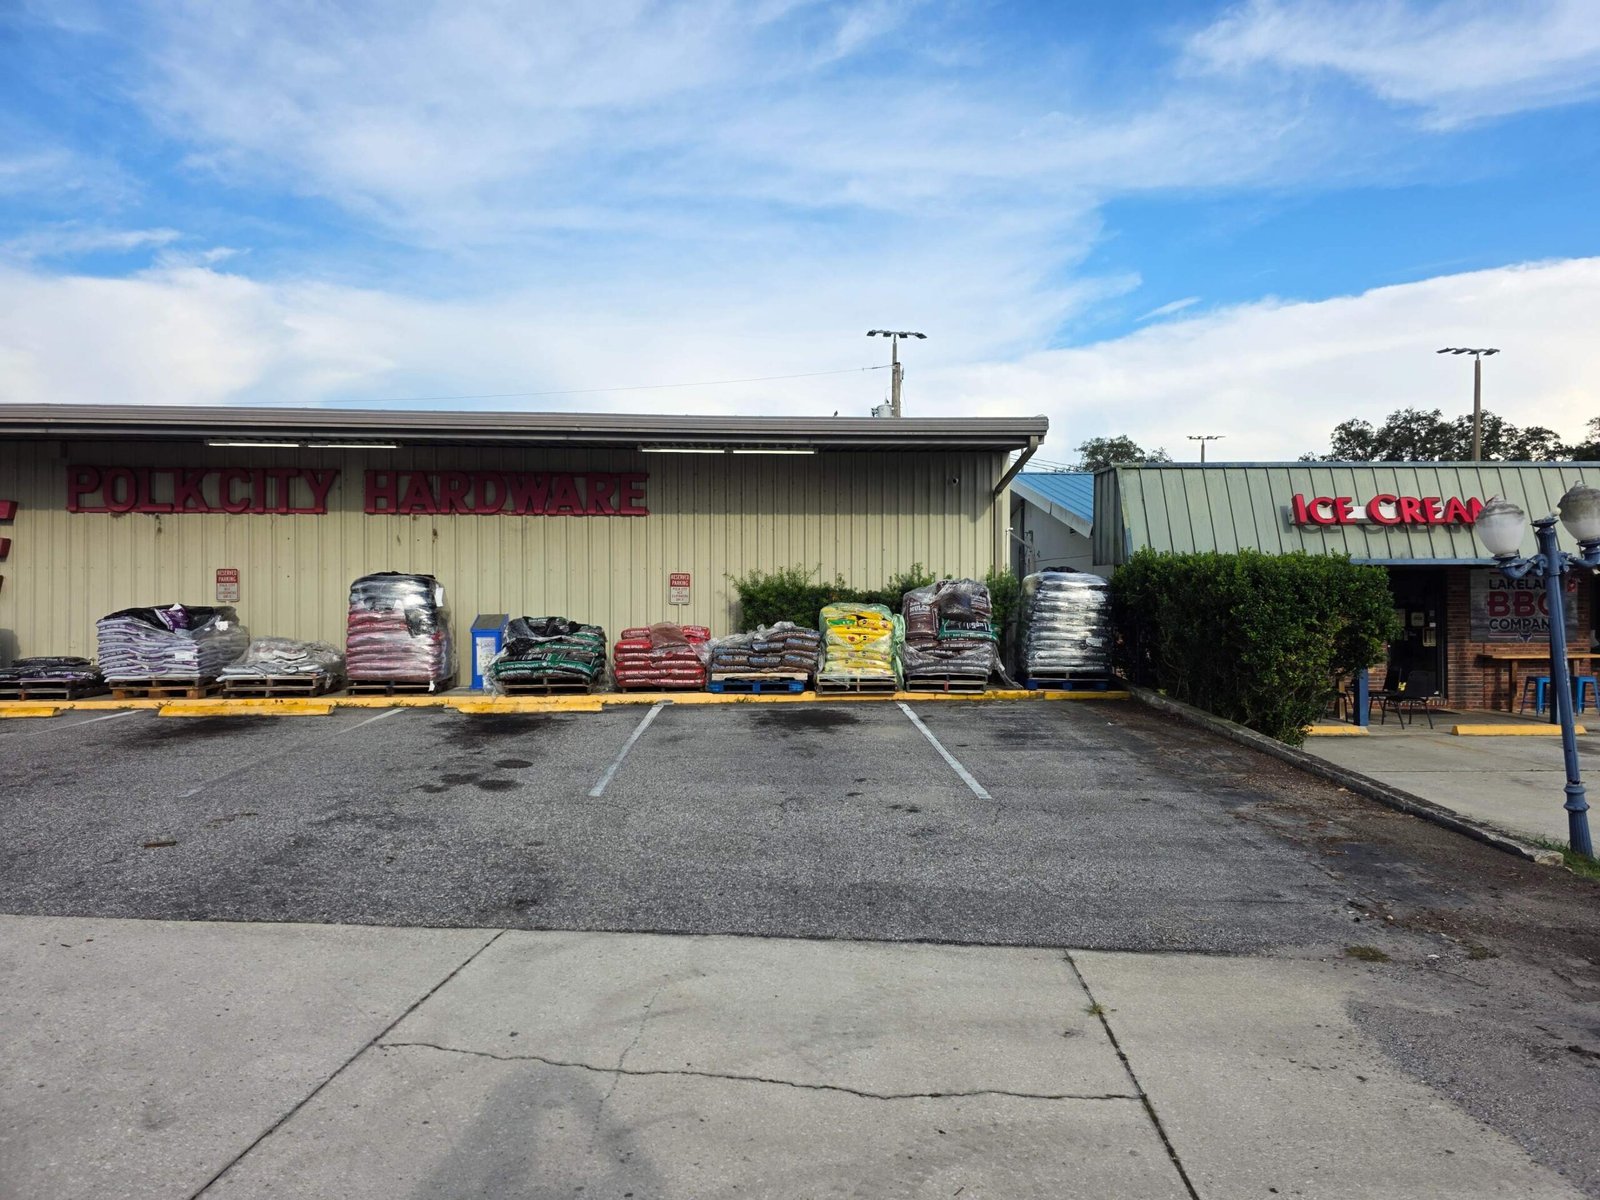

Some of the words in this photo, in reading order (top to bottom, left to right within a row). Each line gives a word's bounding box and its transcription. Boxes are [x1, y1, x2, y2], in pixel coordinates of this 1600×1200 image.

[66, 465, 209, 513] POLK
[218, 467, 341, 514] CITY
[364, 470, 649, 516] HARDWARE
[1292, 493, 1355, 525] ICE
[1488, 579, 1546, 590] LAKELA
[1489, 619, 1550, 631] COMPAN
